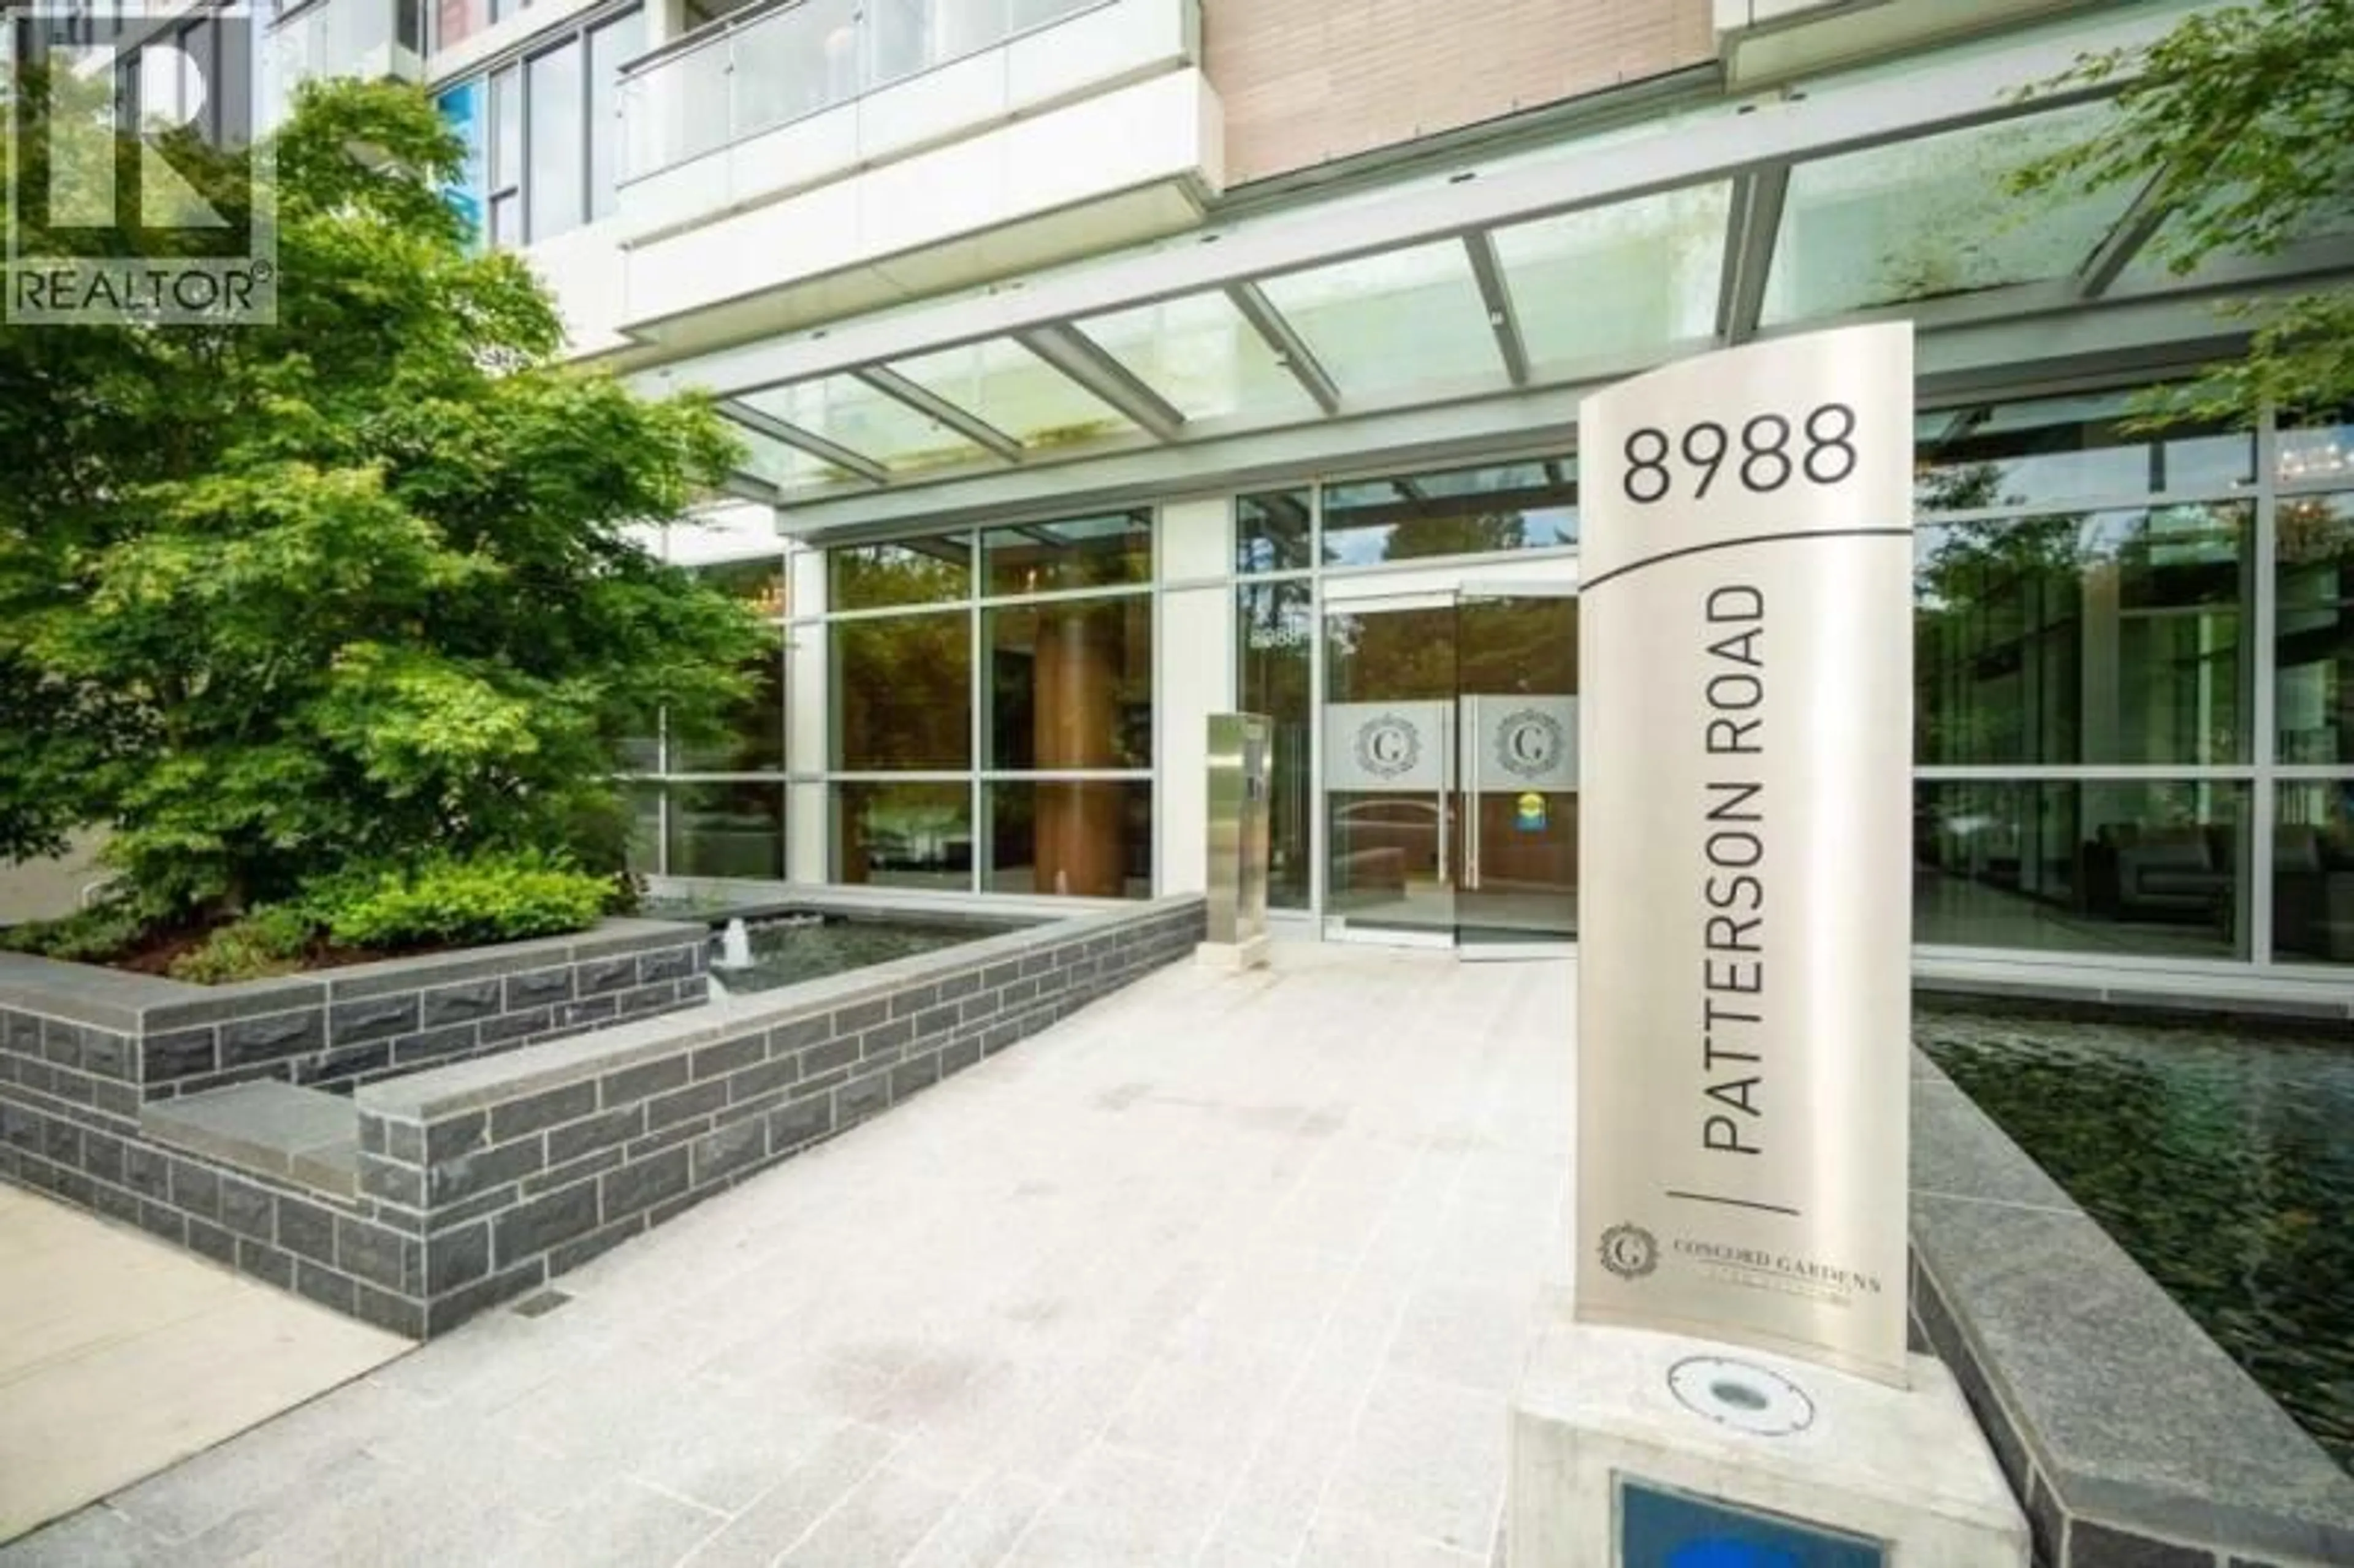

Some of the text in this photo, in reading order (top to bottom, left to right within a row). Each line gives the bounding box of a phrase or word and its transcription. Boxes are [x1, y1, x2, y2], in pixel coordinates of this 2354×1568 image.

[1624, 403, 1857, 503] 8988
[1704, 586, 1763, 1154] PATTERSON ROAD
